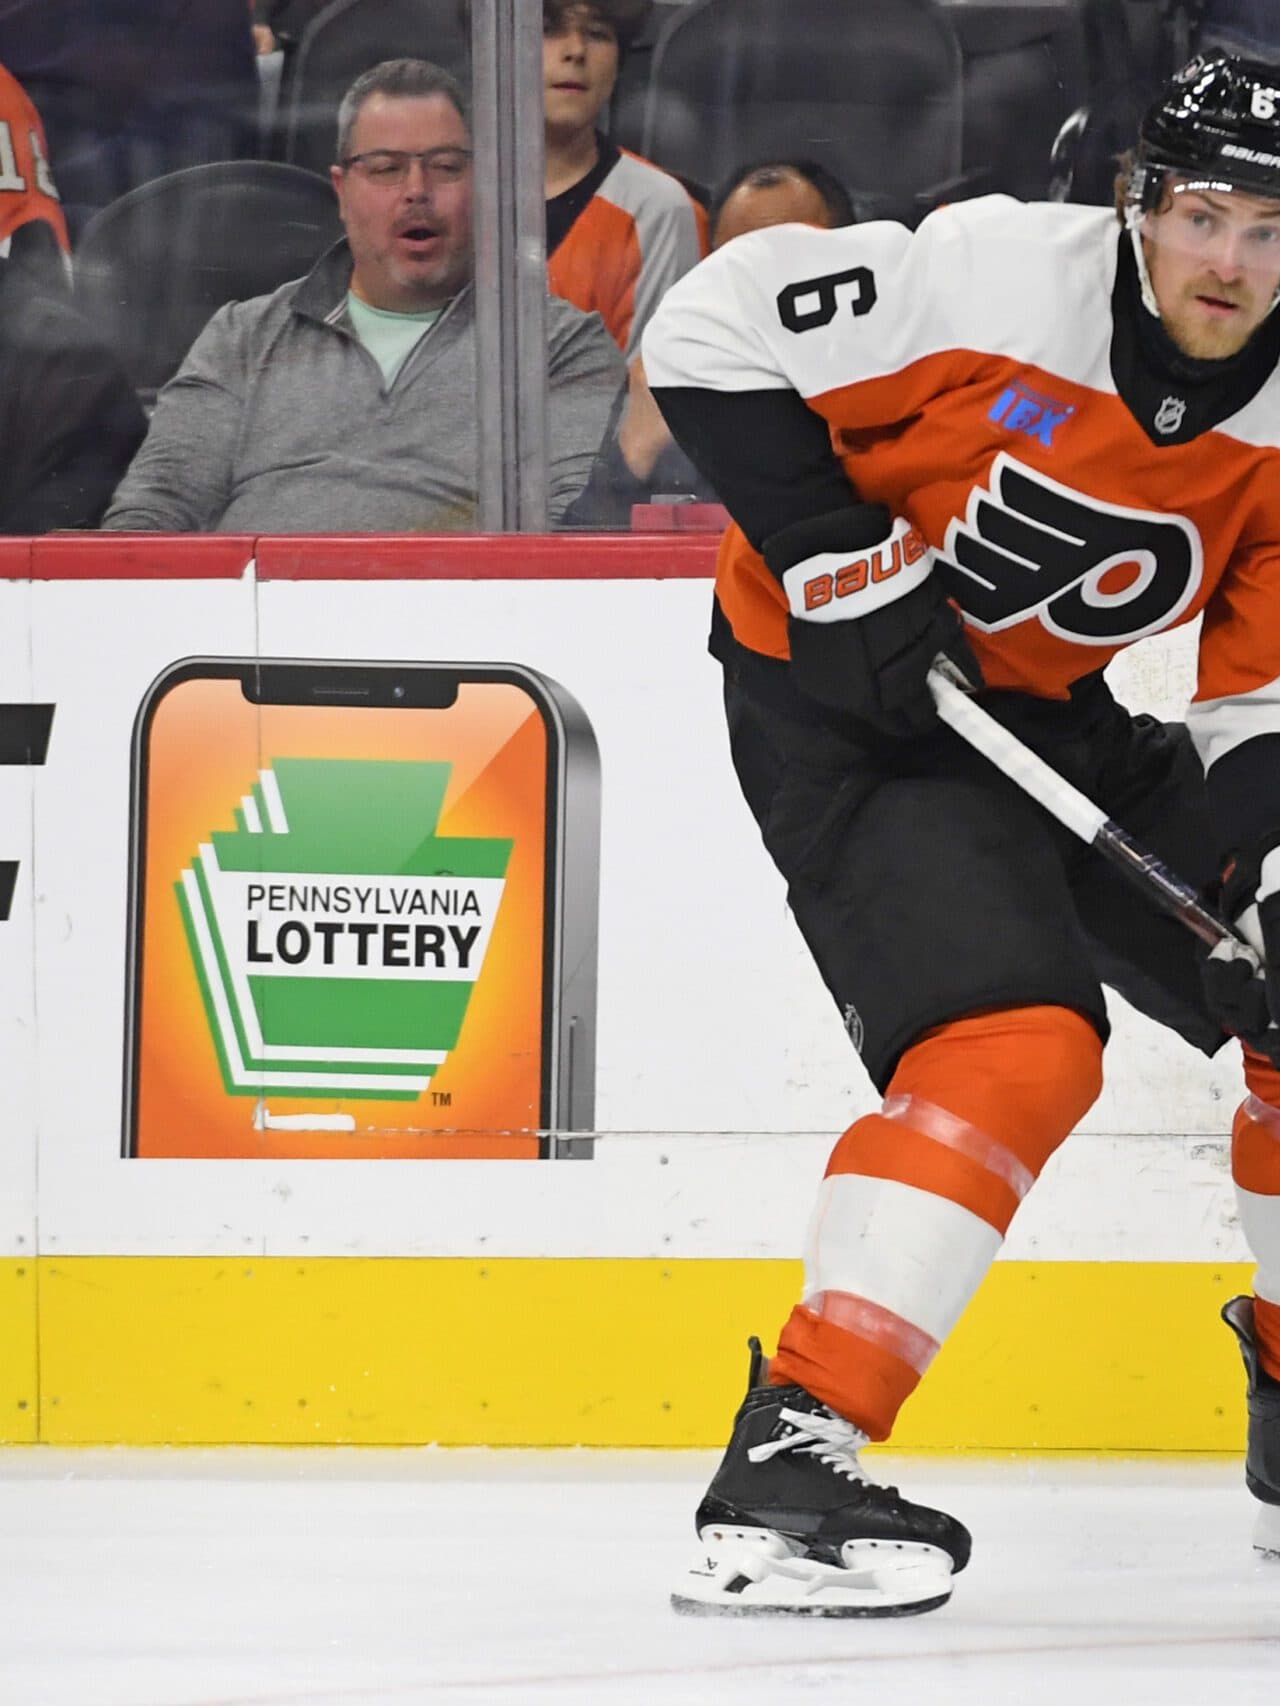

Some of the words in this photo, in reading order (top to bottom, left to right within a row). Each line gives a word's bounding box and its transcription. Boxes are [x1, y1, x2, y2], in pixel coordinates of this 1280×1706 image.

[1250, 89, 1276, 120] 6
[776, 265, 878, 334] 6
[247, 884, 482, 916] PENNSYLVANIA
[247, 919, 482, 968] LOTTERY
[431, 1092, 452, 1106] TM
